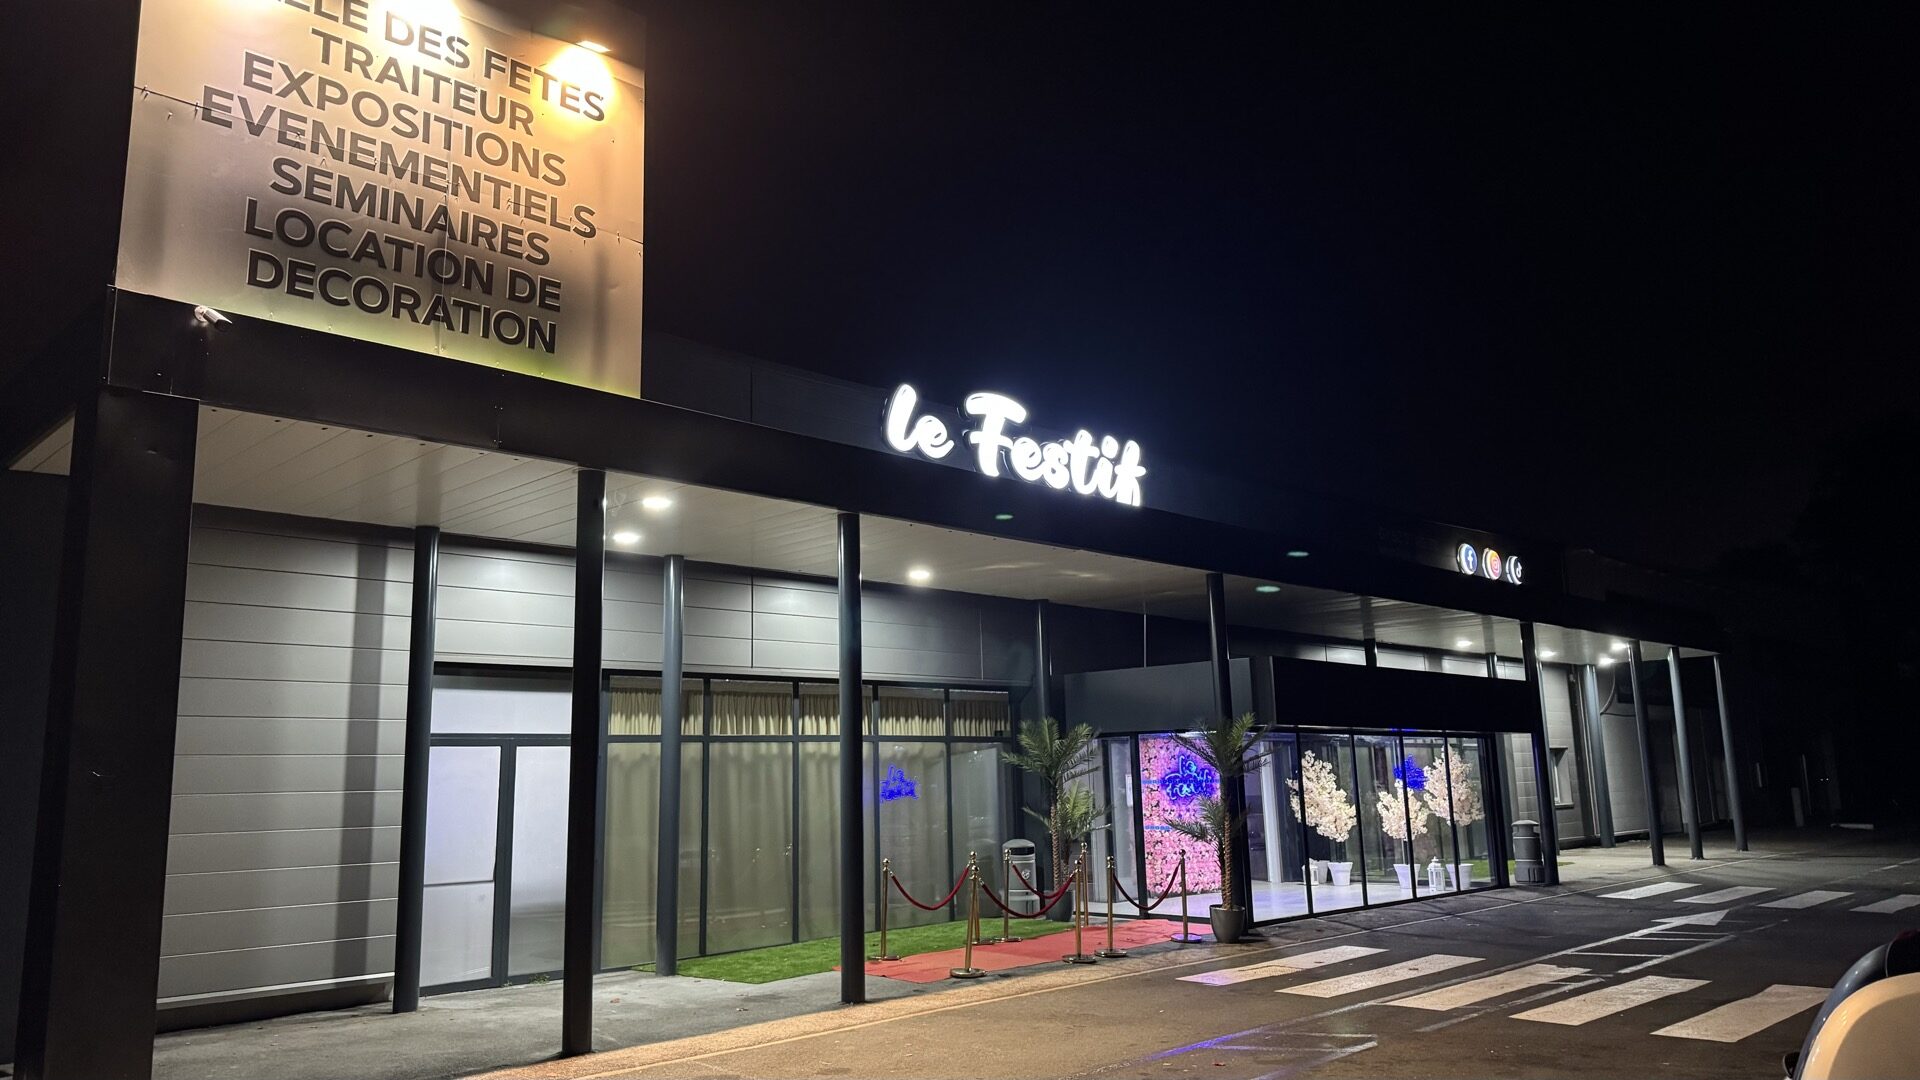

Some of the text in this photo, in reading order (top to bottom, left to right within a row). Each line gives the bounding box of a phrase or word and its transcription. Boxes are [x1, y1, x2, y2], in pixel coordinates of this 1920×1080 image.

[243, 51, 567, 187] EXPOSITIONS
[311, 27, 535, 137] TRAITEUR
[385, 10, 470, 69] DES
[484, 48, 605, 122] FETES
[201, 85, 597, 239] EVENEMENTIELS
[270, 156, 550, 266] SEMINAIRES
[244, 197, 562, 313] LOCATION DE
[246, 248, 557, 354] DECORATION
[886, 383, 1147, 507] le Festif
